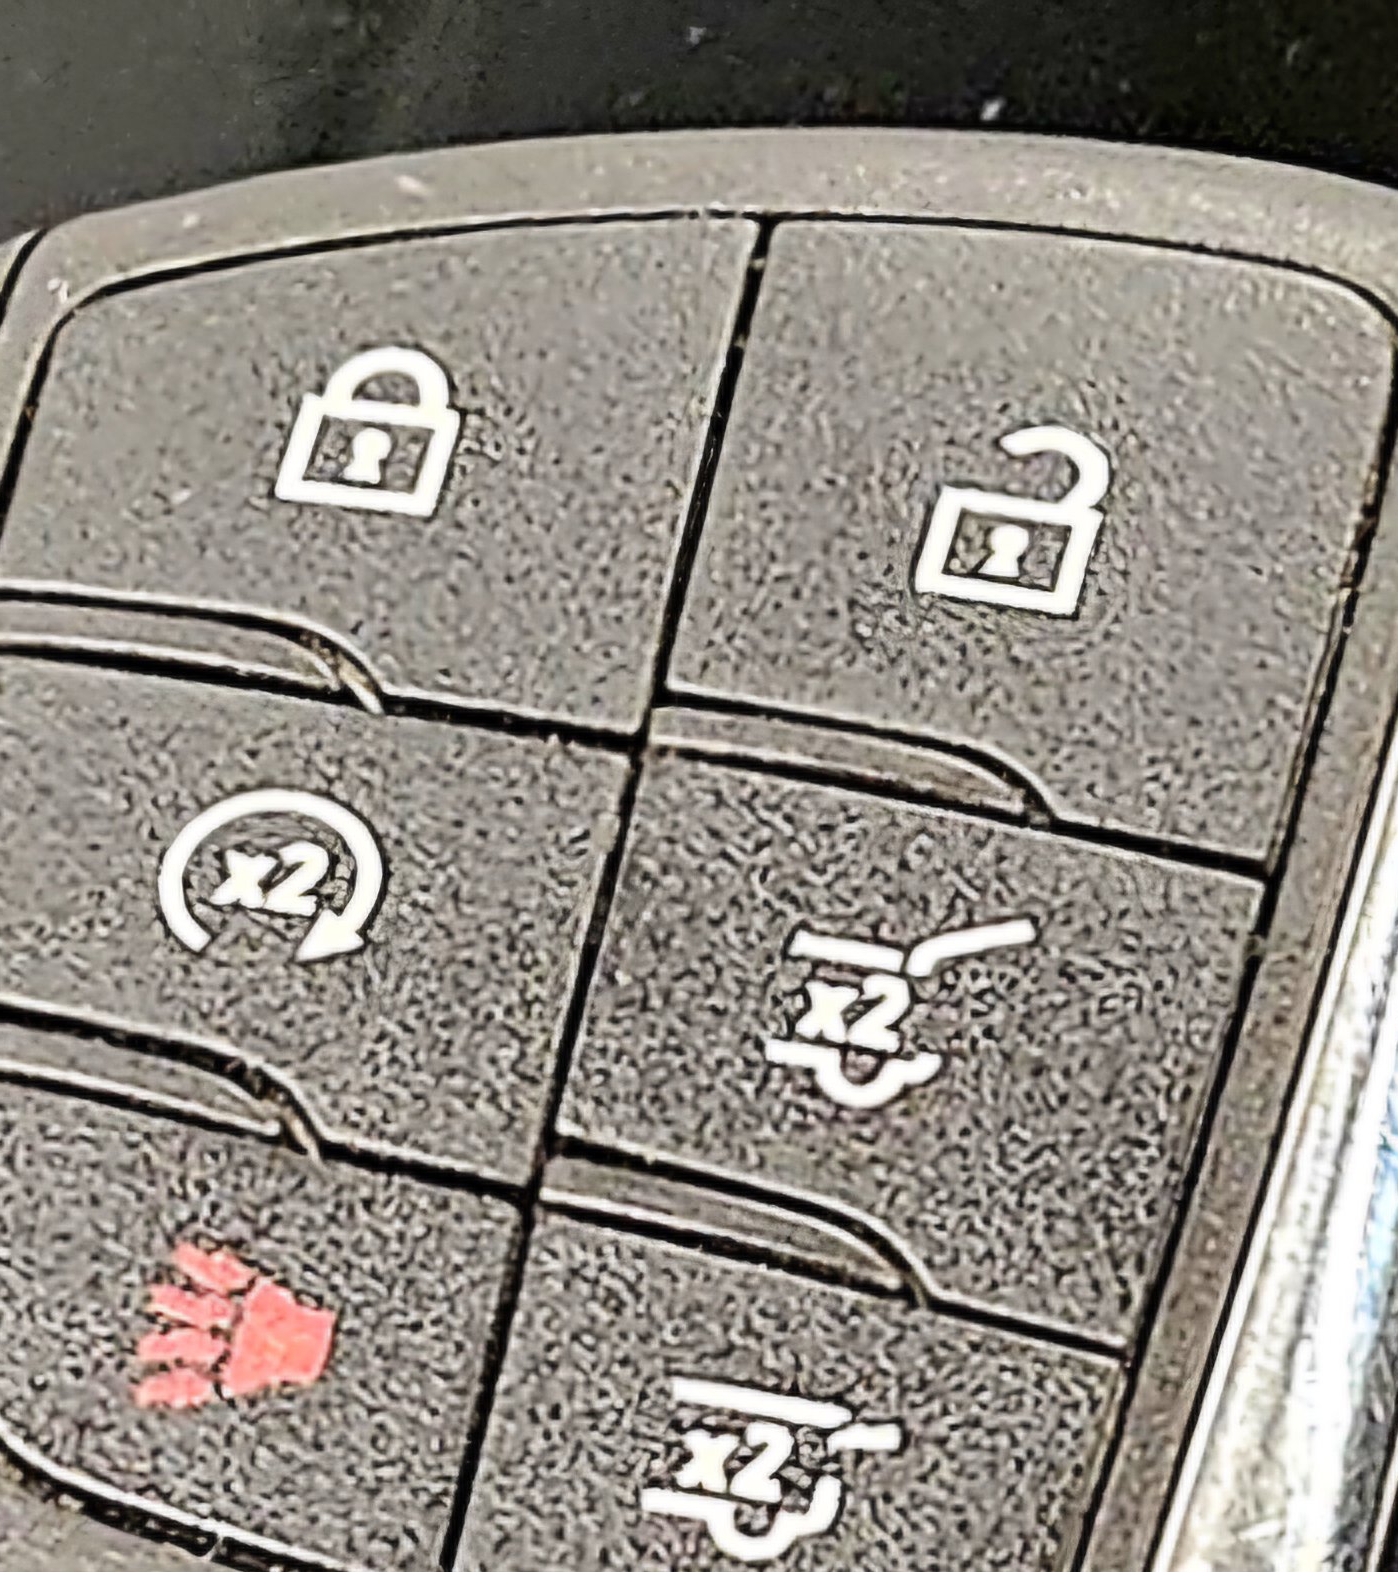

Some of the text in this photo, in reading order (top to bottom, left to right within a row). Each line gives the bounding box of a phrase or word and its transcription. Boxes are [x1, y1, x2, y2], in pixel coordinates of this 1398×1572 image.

[209, 840, 330, 917] x2
[795, 974, 910, 1053] x2
[674, 1421, 795, 1504] x2
